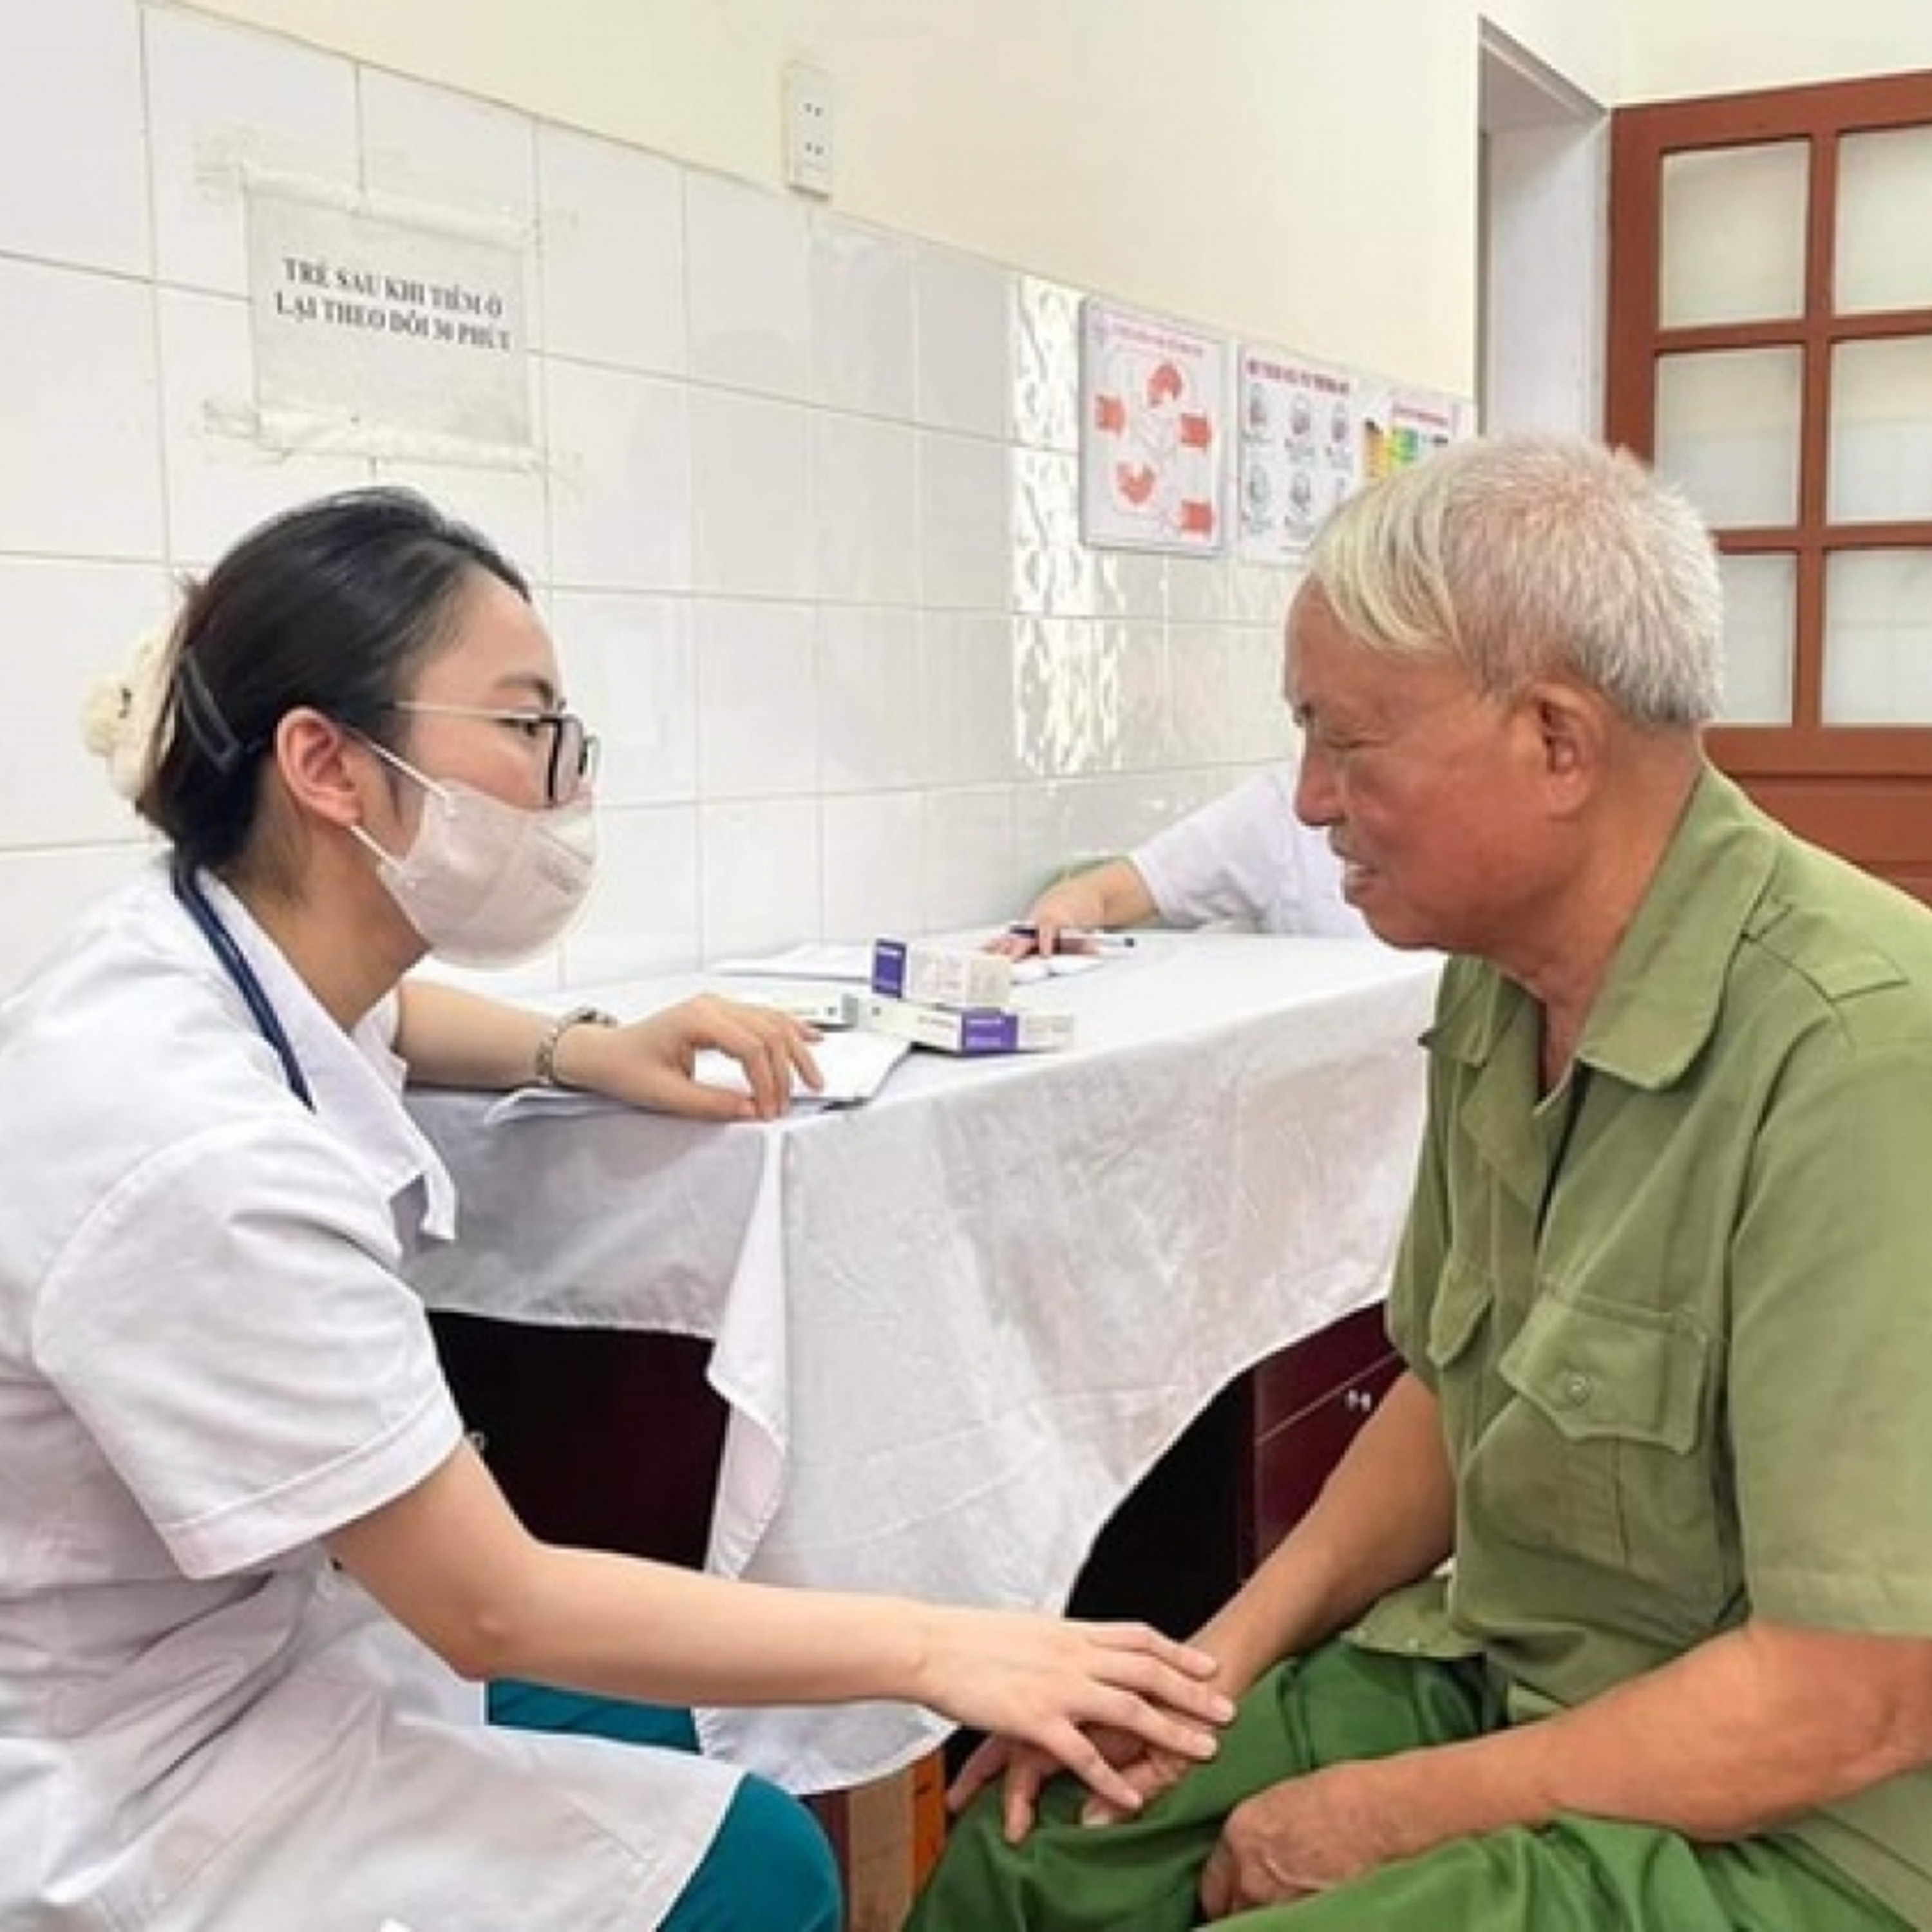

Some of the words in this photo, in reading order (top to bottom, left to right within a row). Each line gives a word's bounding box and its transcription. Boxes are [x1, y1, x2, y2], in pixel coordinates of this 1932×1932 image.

[334, 265, 377, 295] SAU
[384, 276, 425, 306] KHI
[322, 300, 386, 330] THEO
